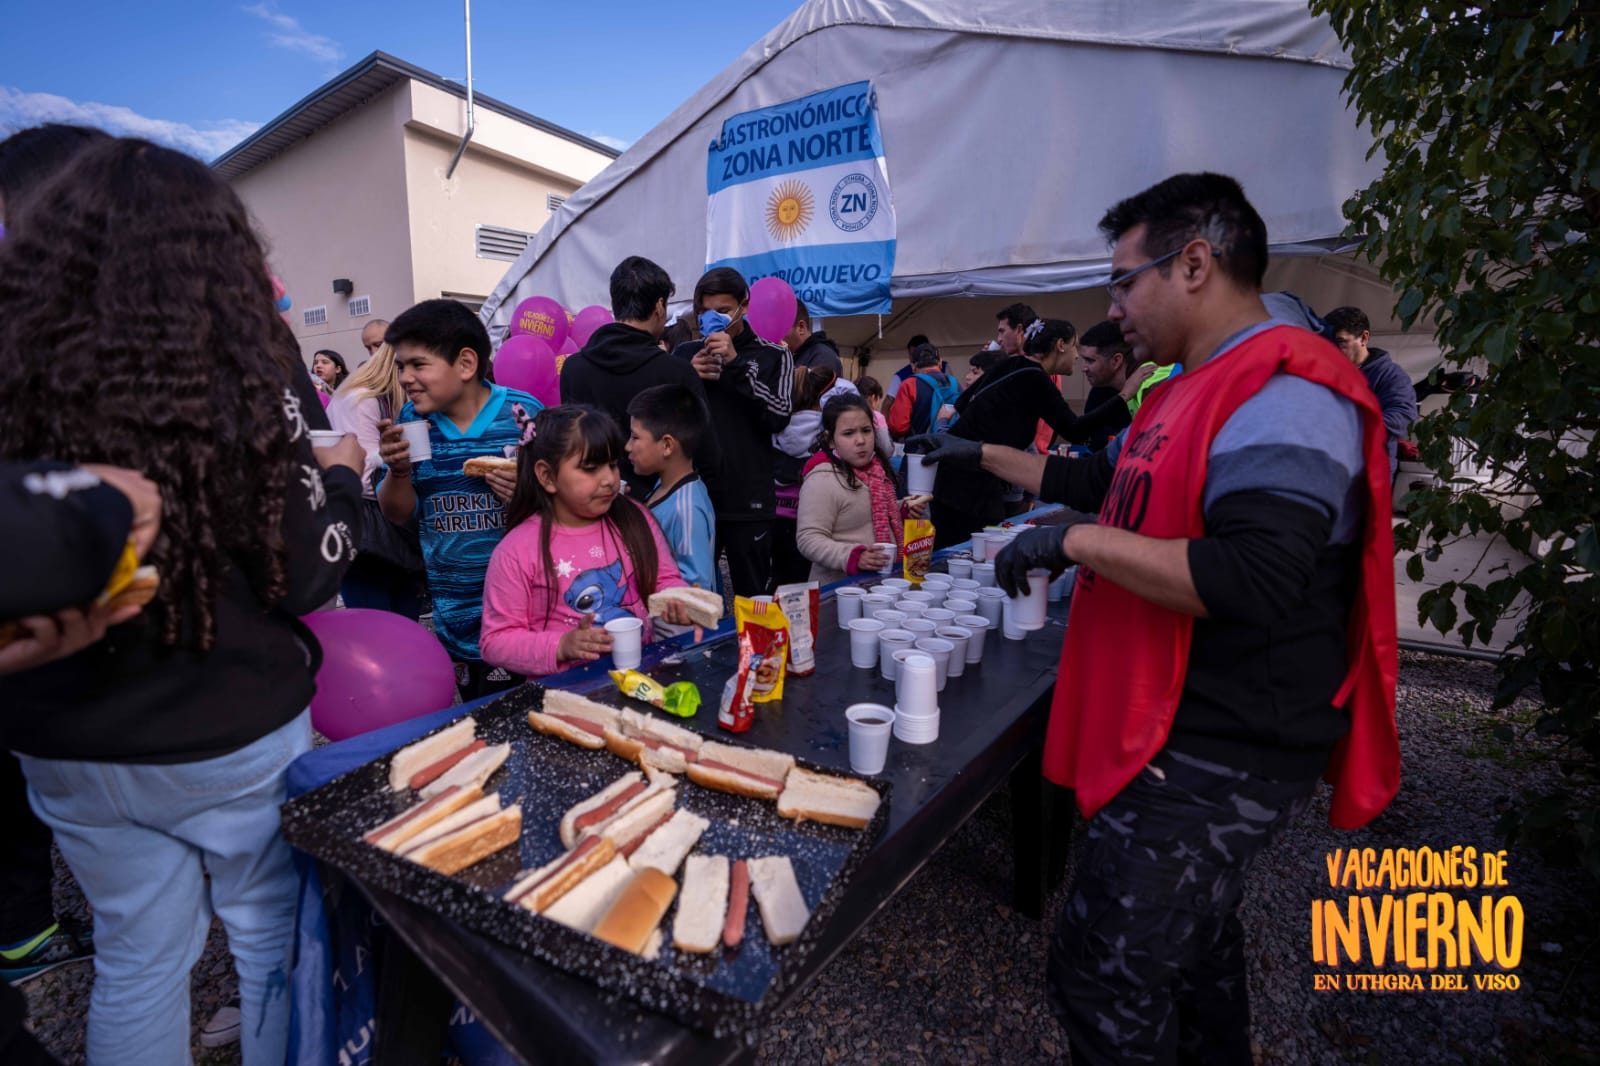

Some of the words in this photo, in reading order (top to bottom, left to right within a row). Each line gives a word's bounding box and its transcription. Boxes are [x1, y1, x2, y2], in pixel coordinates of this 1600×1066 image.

[722, 143, 782, 181] ZONA
[788, 124, 872, 164] NORTE
[840, 192, 867, 213] ZN
[750, 264, 881, 287] RIONUEVO
[520, 318, 555, 337] INVIERNO
[431, 493, 506, 513] TURKIS
[434, 511, 509, 533] AIRLINE
